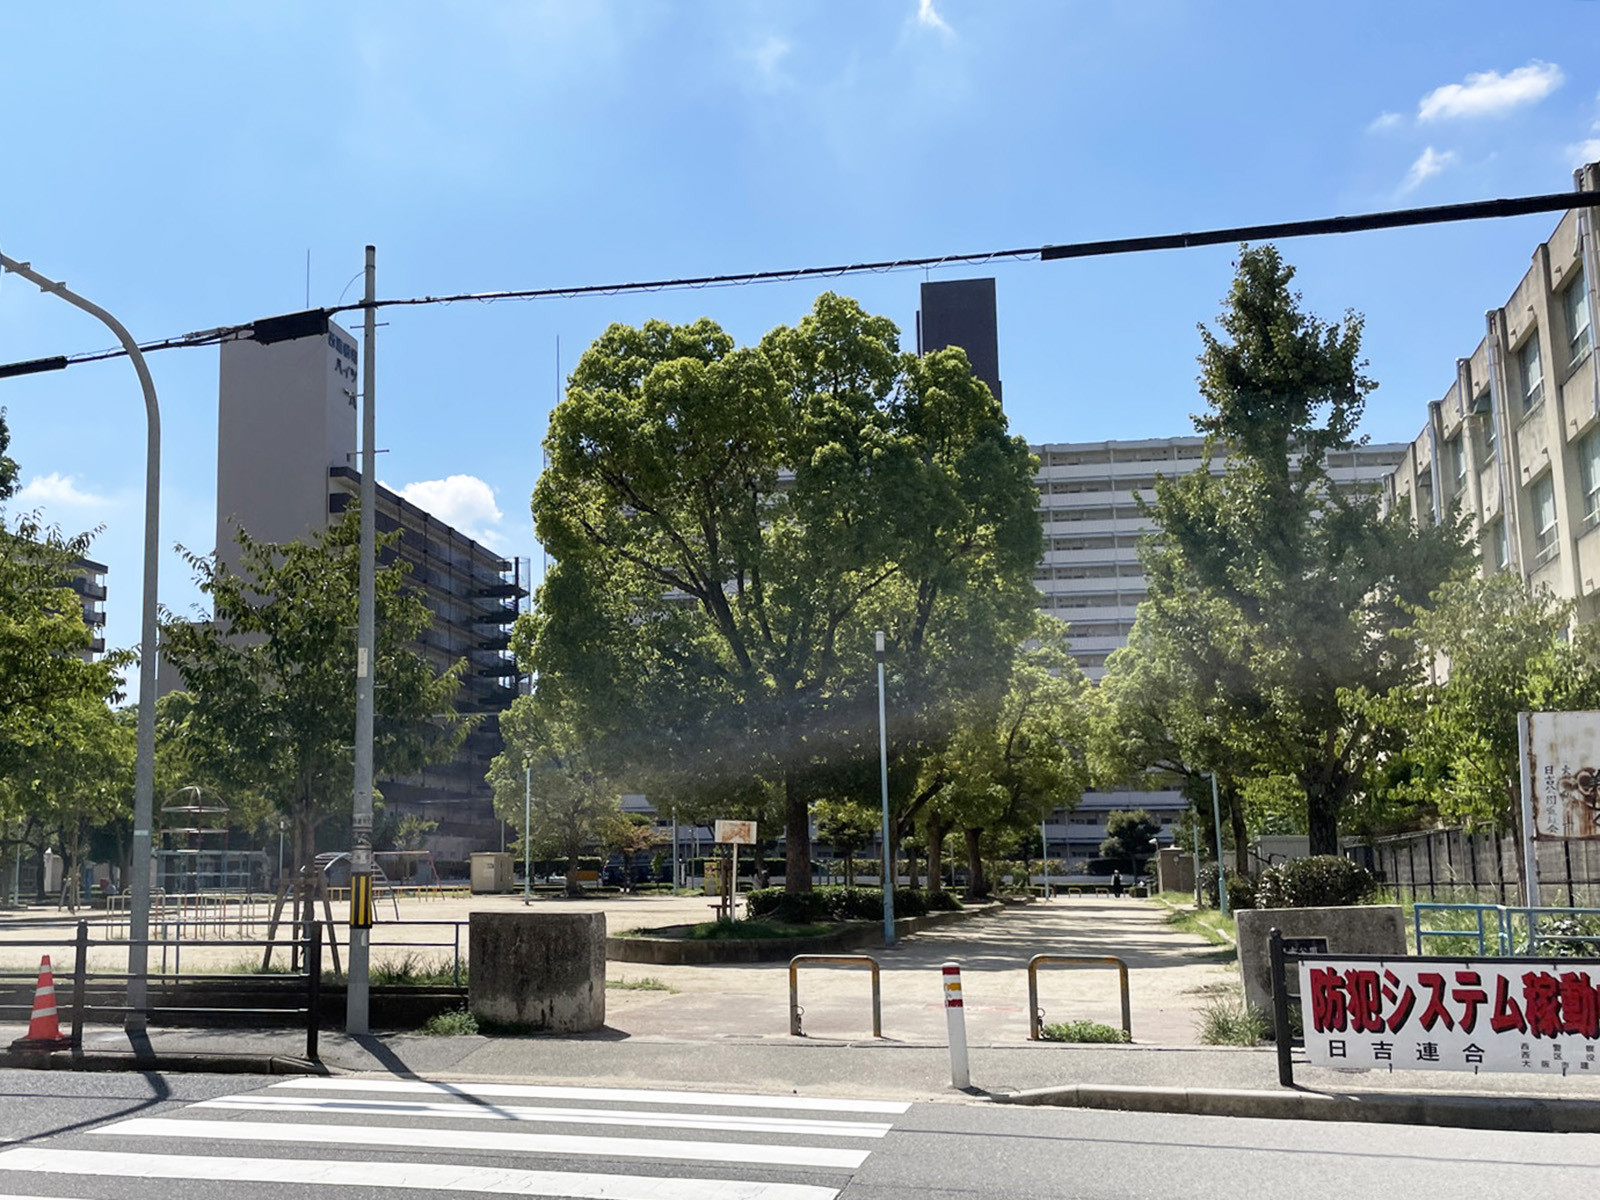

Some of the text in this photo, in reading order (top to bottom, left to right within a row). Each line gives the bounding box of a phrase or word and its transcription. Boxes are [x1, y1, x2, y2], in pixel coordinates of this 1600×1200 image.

[1309, 966, 1600, 1040] 防犯システム稼動
[1328, 1040, 1485, 1064] 日吉連合
